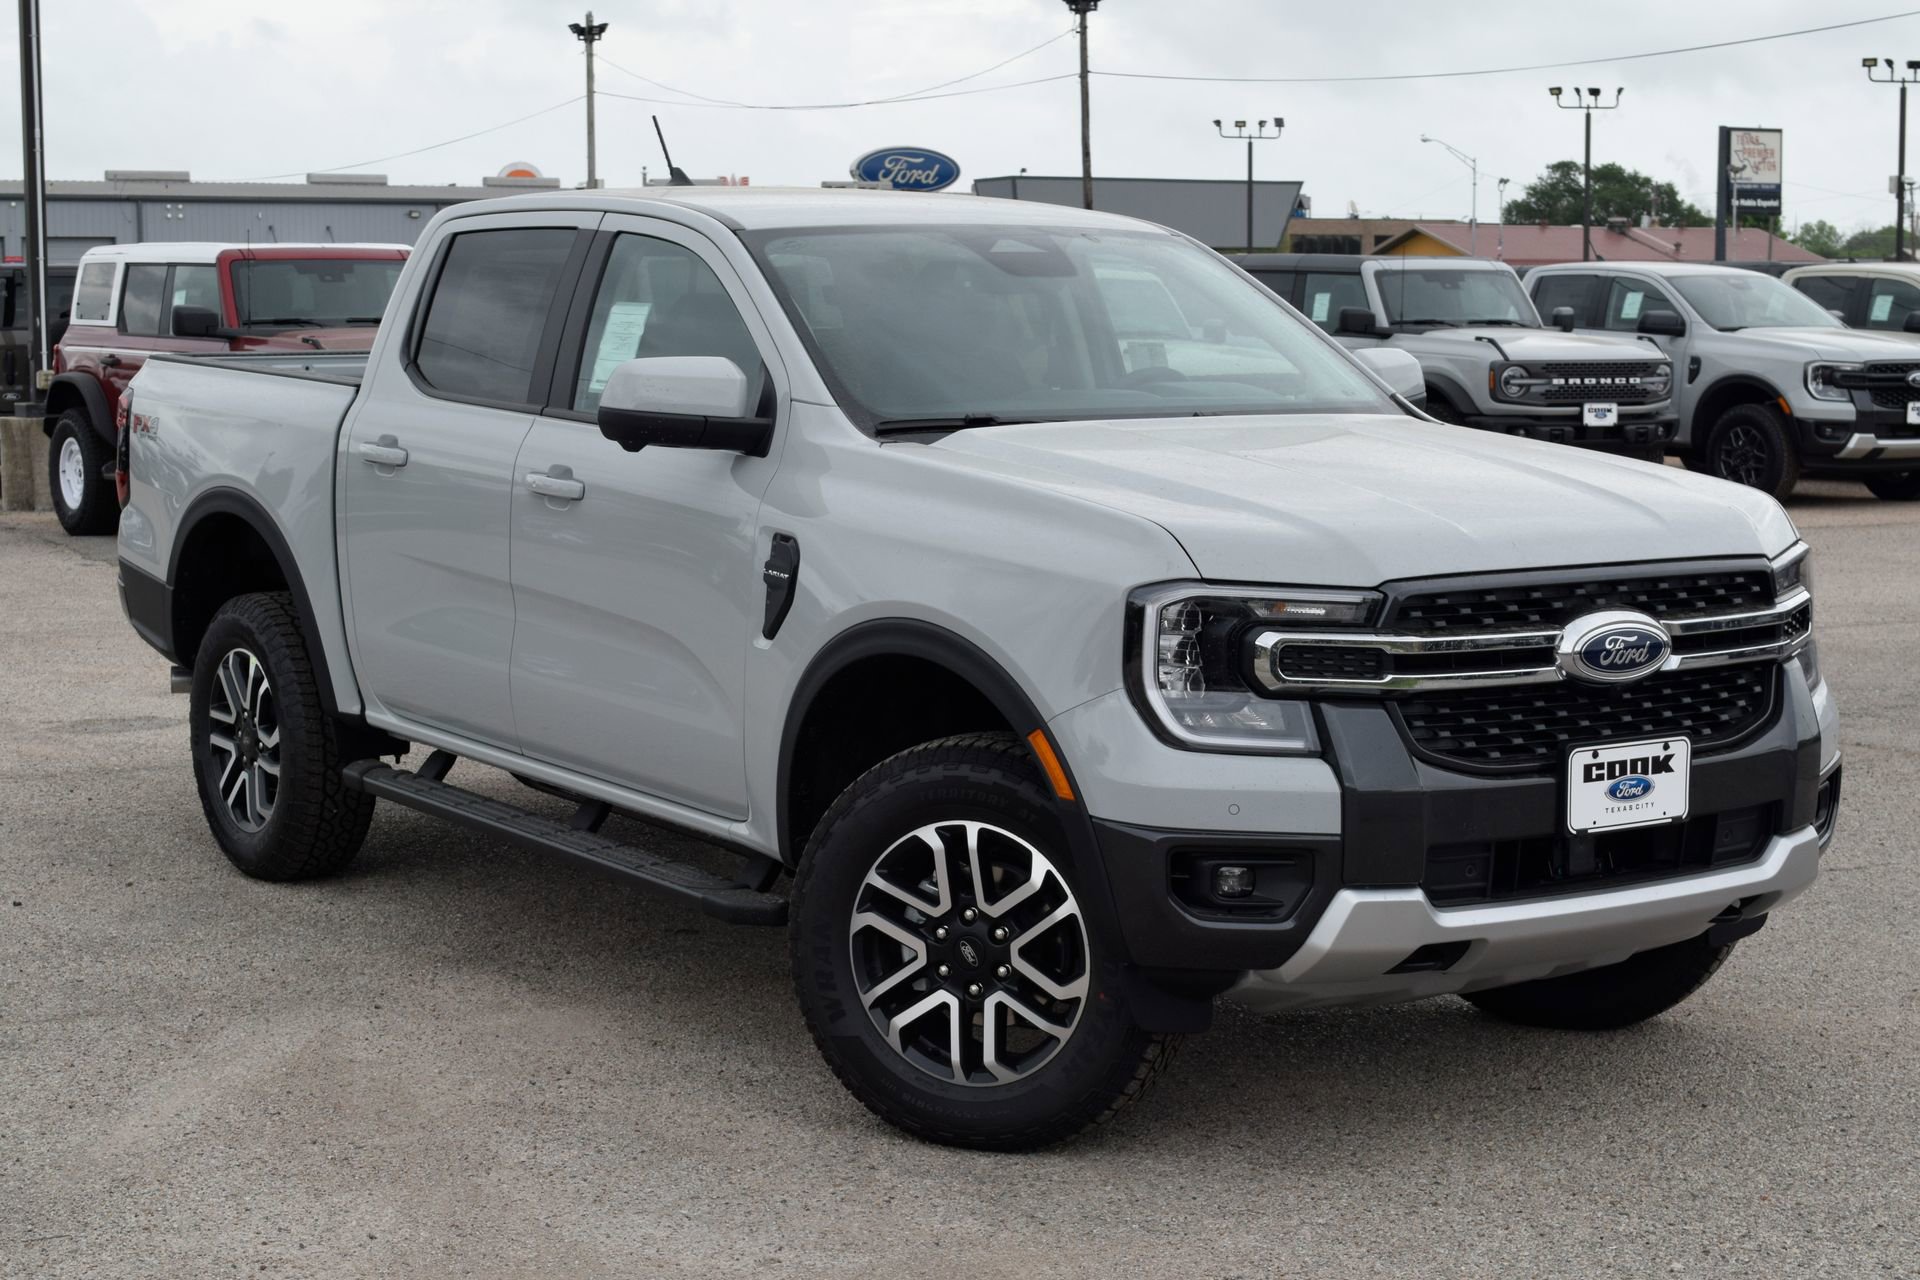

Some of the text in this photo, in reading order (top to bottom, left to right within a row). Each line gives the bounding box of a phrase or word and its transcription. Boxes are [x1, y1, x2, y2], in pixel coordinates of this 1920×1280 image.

[878, 155, 940, 184] Ford
[1551, 377, 1642, 385] BRONCO
[763, 568, 788, 579] LARIAT
[1600, 635, 1650, 666] Ford
[1583, 753, 1676, 783] COOK
[919, 787, 1009, 807] TERRITORY
[1616, 780, 1644, 798] Ford
